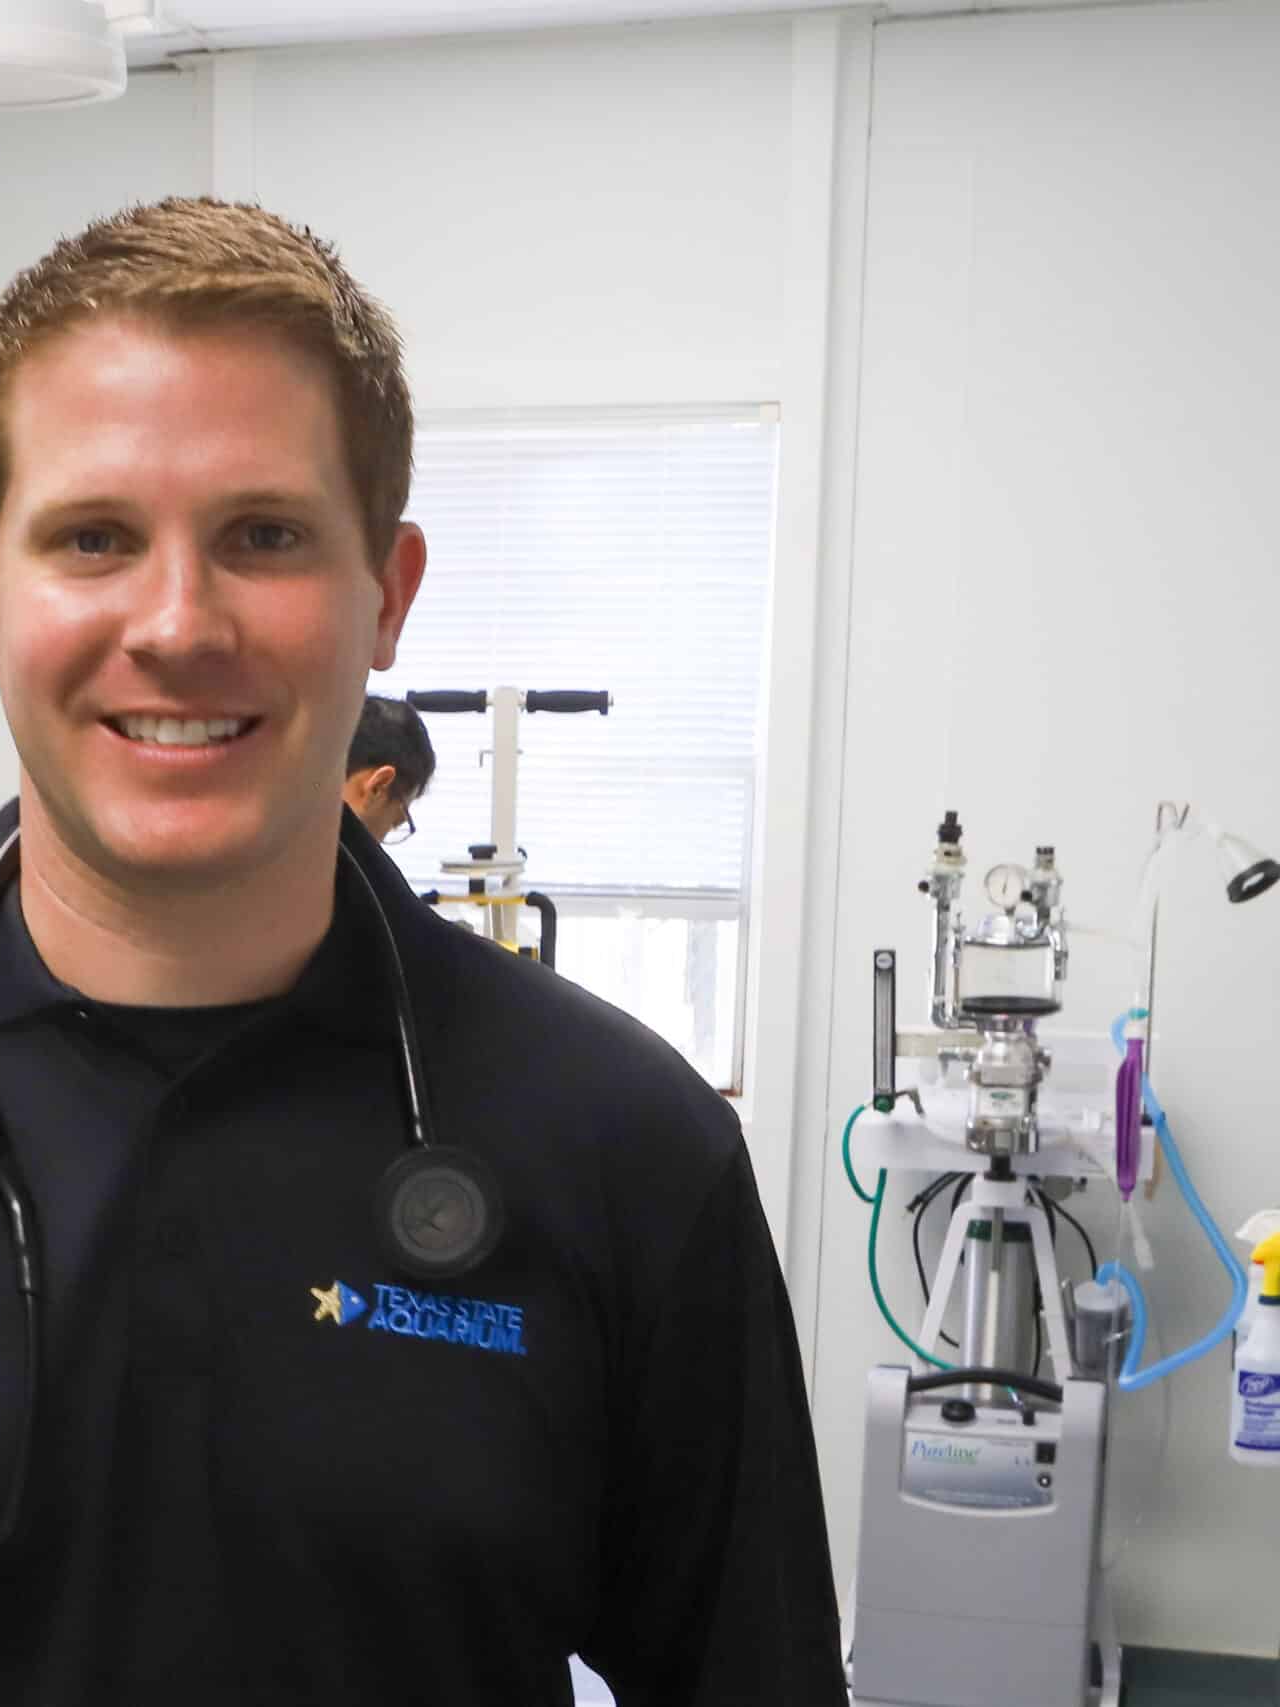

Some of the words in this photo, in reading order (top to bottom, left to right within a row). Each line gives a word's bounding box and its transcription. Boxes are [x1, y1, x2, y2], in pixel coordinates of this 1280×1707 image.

[372, 1283, 449, 1317] TEXAS
[455, 1299, 523, 1330] STATE
[368, 1307, 523, 1354] AQUARIUM
